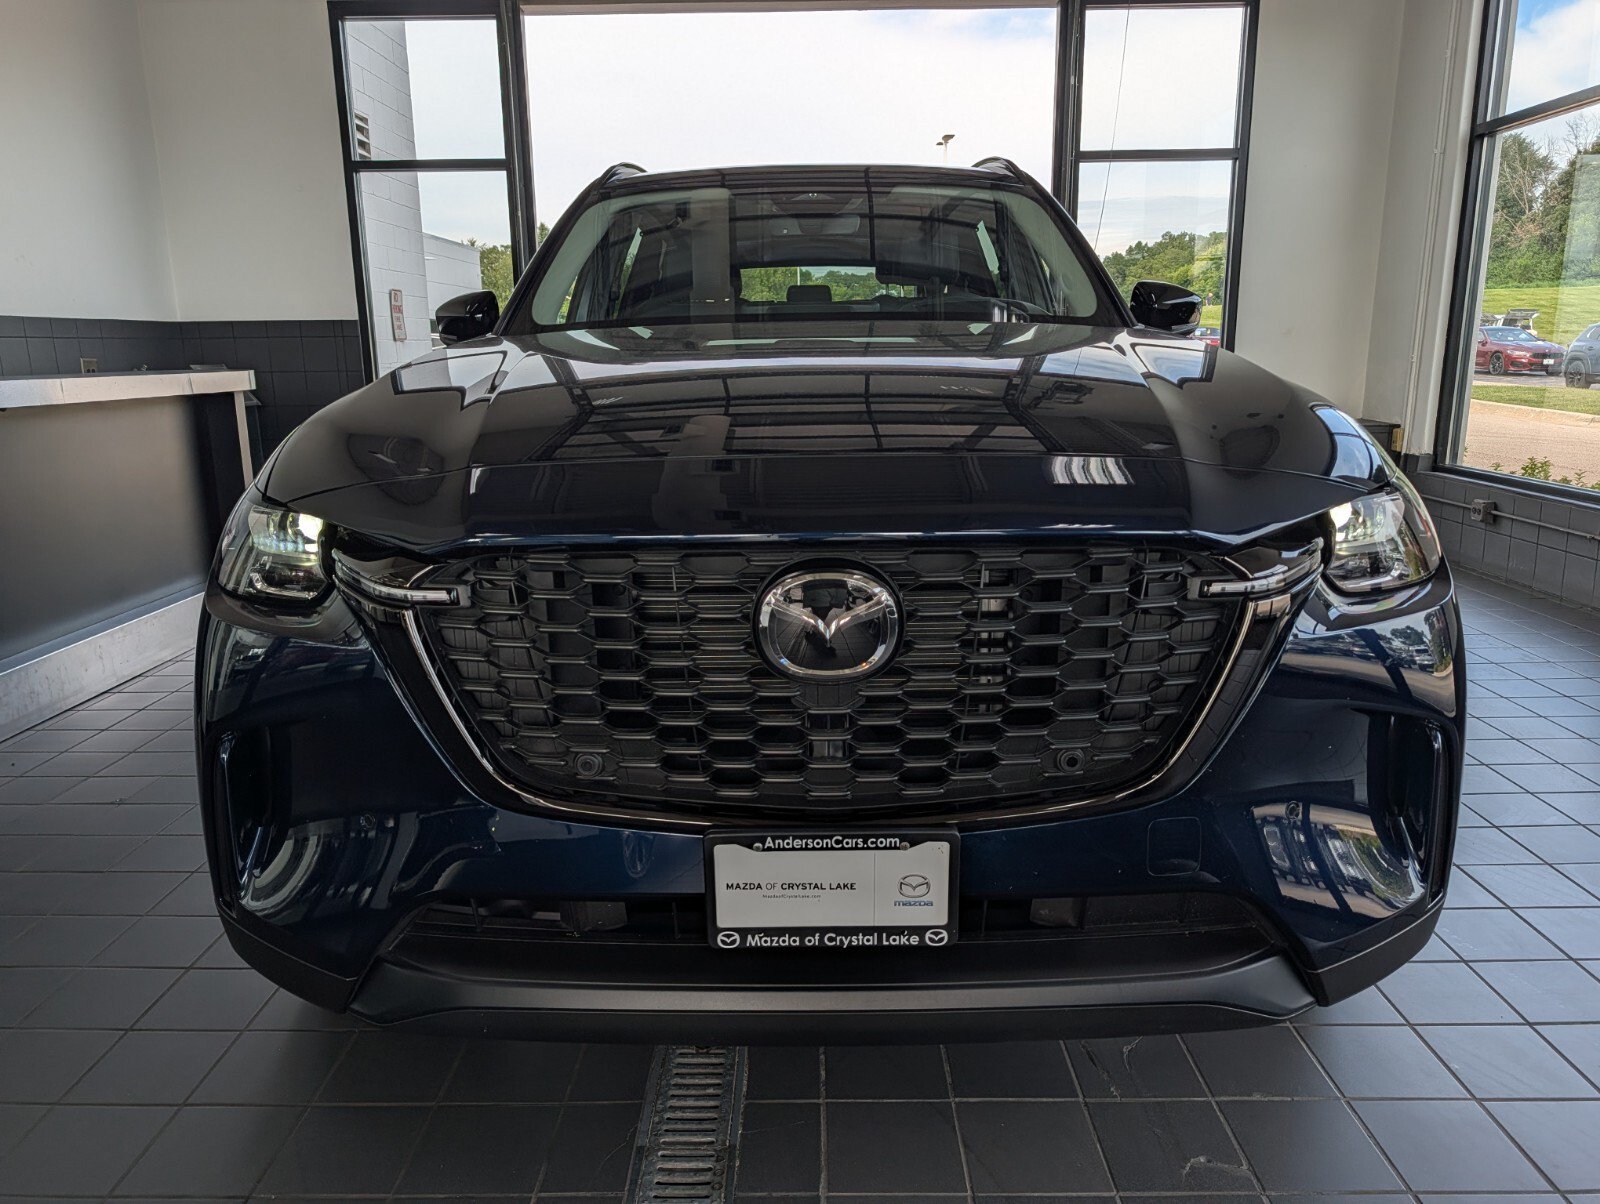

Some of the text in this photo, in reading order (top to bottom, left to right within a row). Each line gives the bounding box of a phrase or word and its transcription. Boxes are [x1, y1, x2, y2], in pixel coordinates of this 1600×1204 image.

[764, 837, 900, 849] AndersonCars.com
[746, 932, 919, 949] Mazda of Crystal Lake
